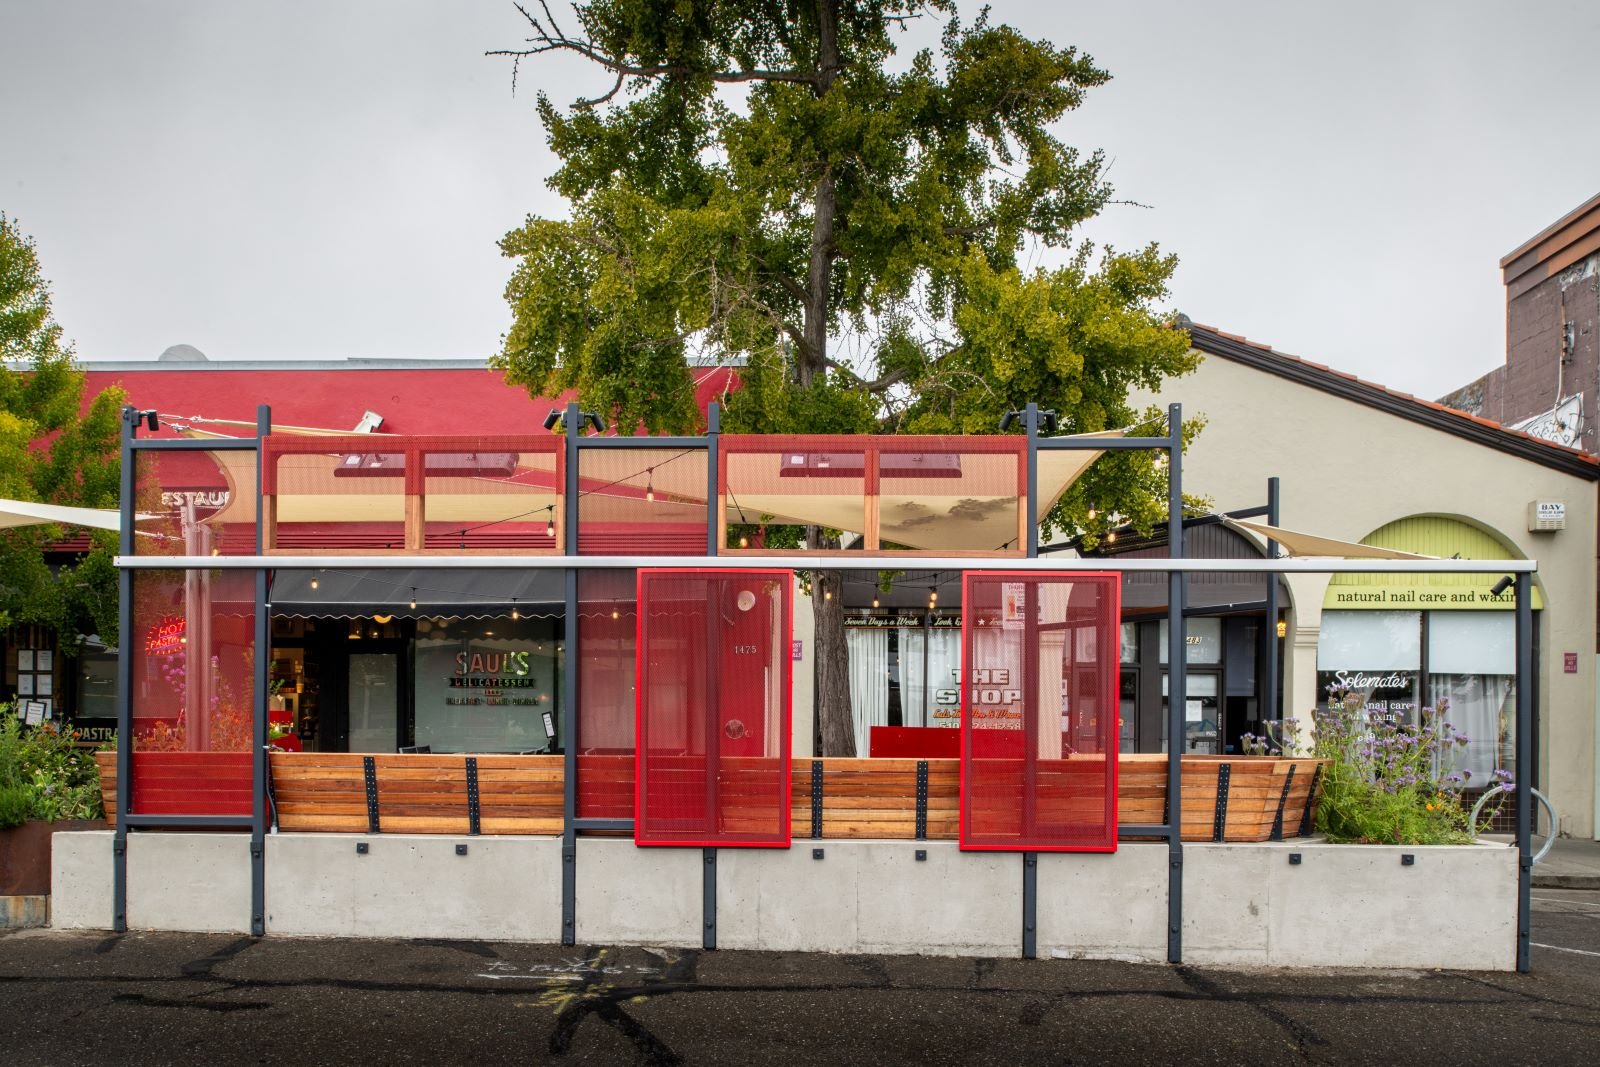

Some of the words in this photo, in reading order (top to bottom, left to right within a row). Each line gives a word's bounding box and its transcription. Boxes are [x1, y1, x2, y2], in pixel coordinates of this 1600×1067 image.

[1337, 590, 1386, 602] natural
[1390, 590, 1416, 602] nail
[1419, 593, 1447, 602] care
[1450, 590, 1475, 602] and
[1479, 590, 1516, 602] waxin
[159, 621, 186, 636] HOT
[735, 645, 757, 654] 1475
[455, 651, 529, 676] SAUL'S
[455, 679, 530, 688] DELICATESSEN
[952, 669, 1010, 685] THE
[1331, 670, 1408, 689] Solemates
[1368, 700, 1388, 710] nail
